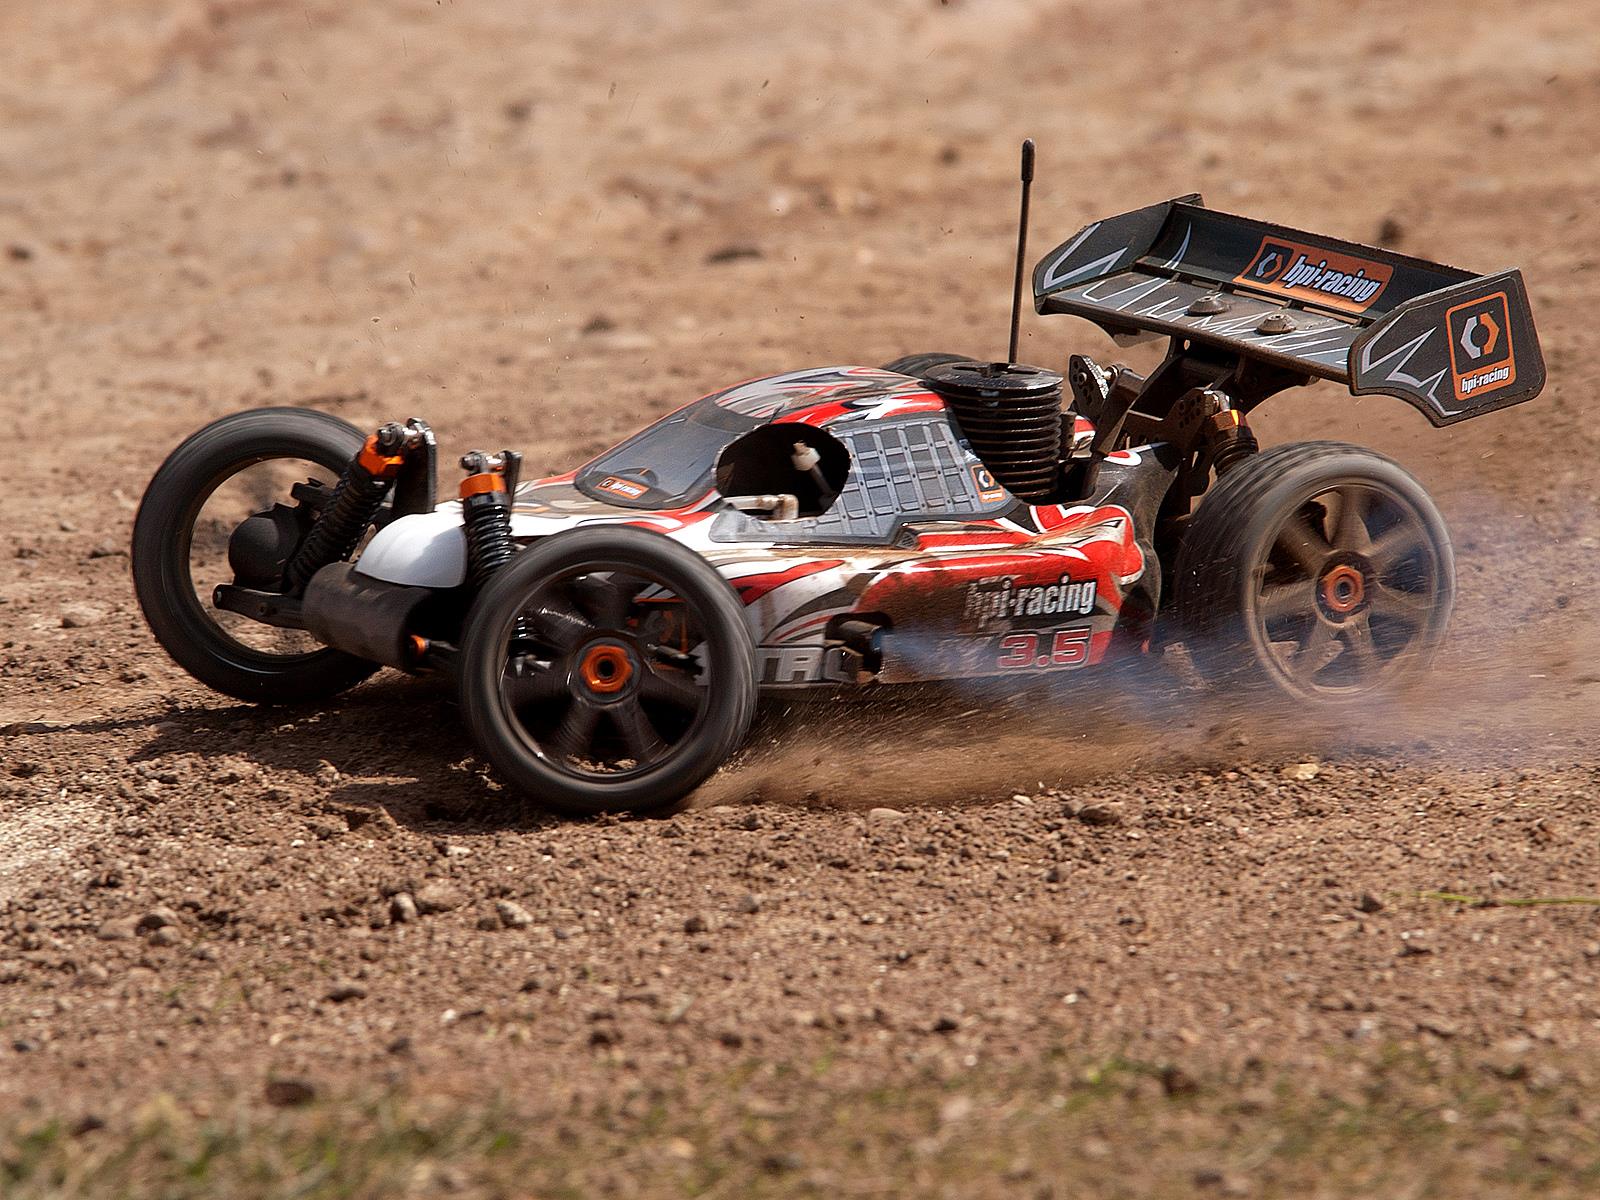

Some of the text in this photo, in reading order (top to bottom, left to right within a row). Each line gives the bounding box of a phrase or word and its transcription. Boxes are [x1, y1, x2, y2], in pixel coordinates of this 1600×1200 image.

[1282, 255, 1381, 302] hpi-racing
[1461, 366, 1510, 394] hpi-racing
[997, 628, 1090, 669] 3.5
